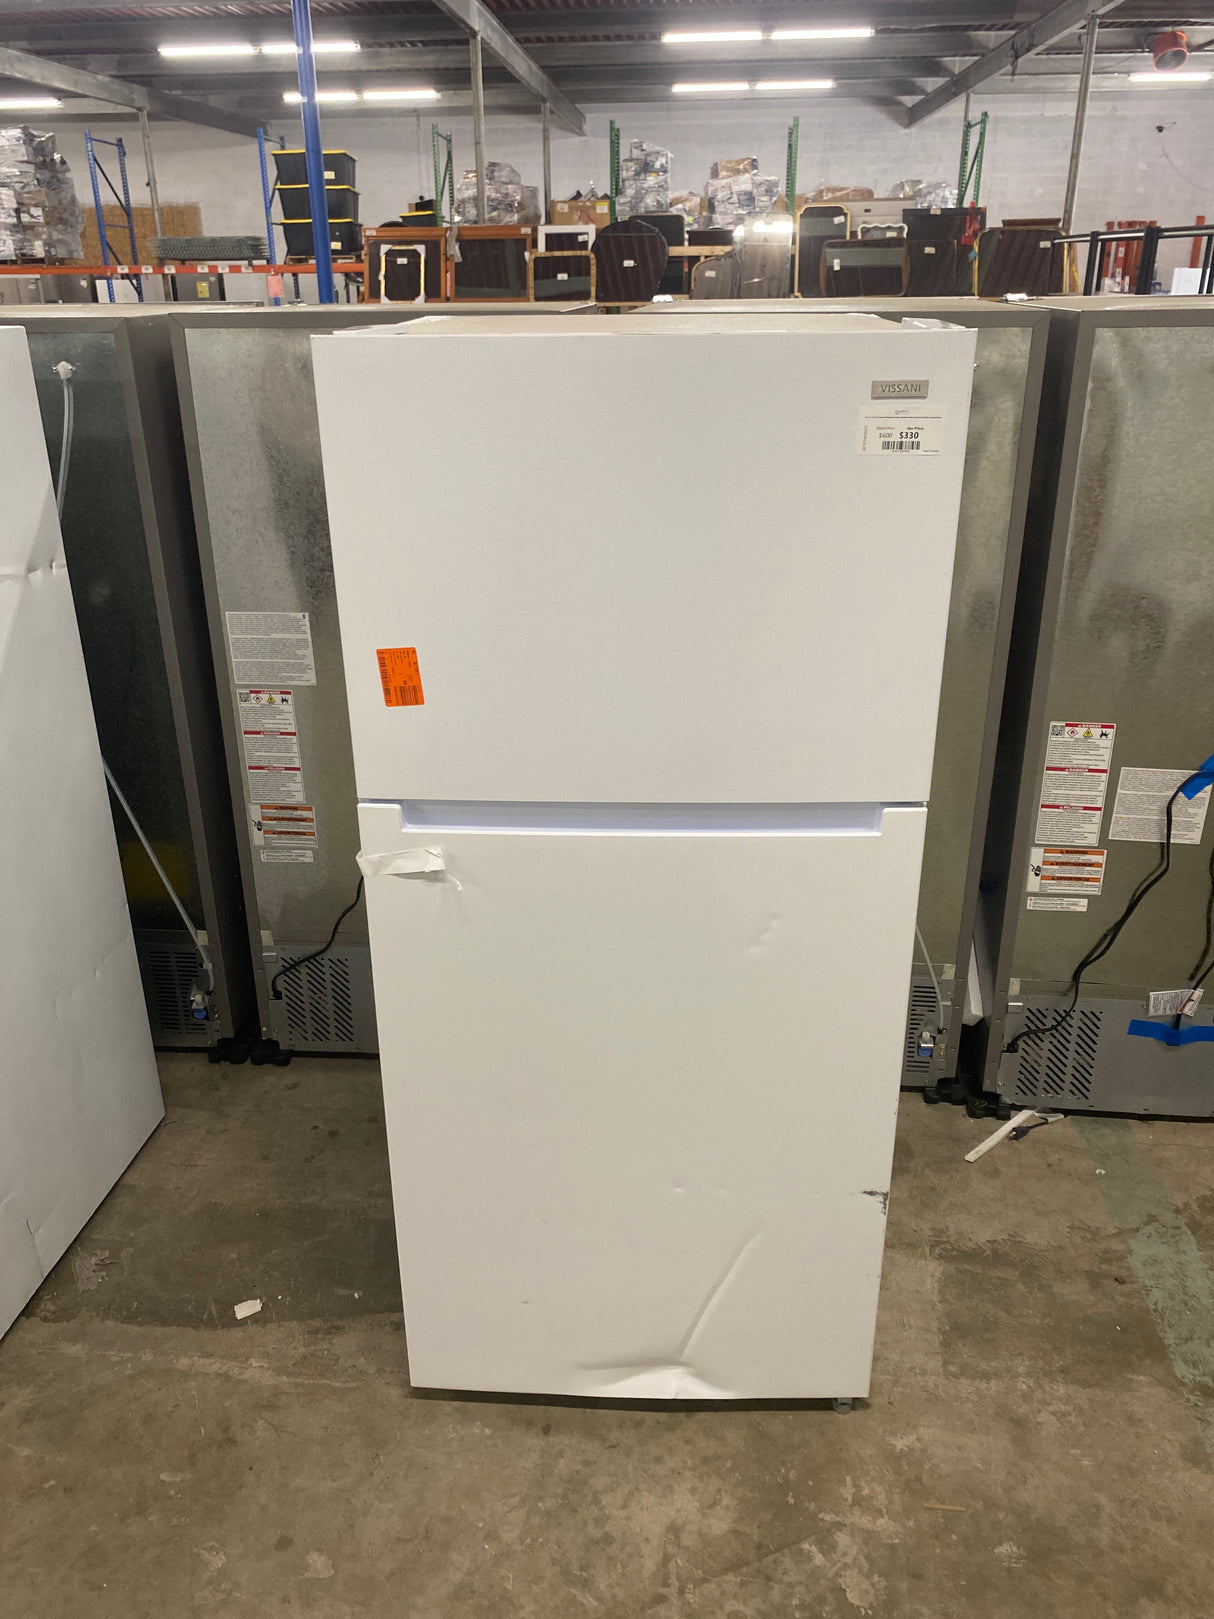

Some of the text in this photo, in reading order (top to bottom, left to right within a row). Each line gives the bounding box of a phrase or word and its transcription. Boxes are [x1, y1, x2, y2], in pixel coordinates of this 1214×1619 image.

[880, 383, 921, 393] VISSANI
[878, 431, 893, 439] $600
[899, 431, 919, 440] $330
